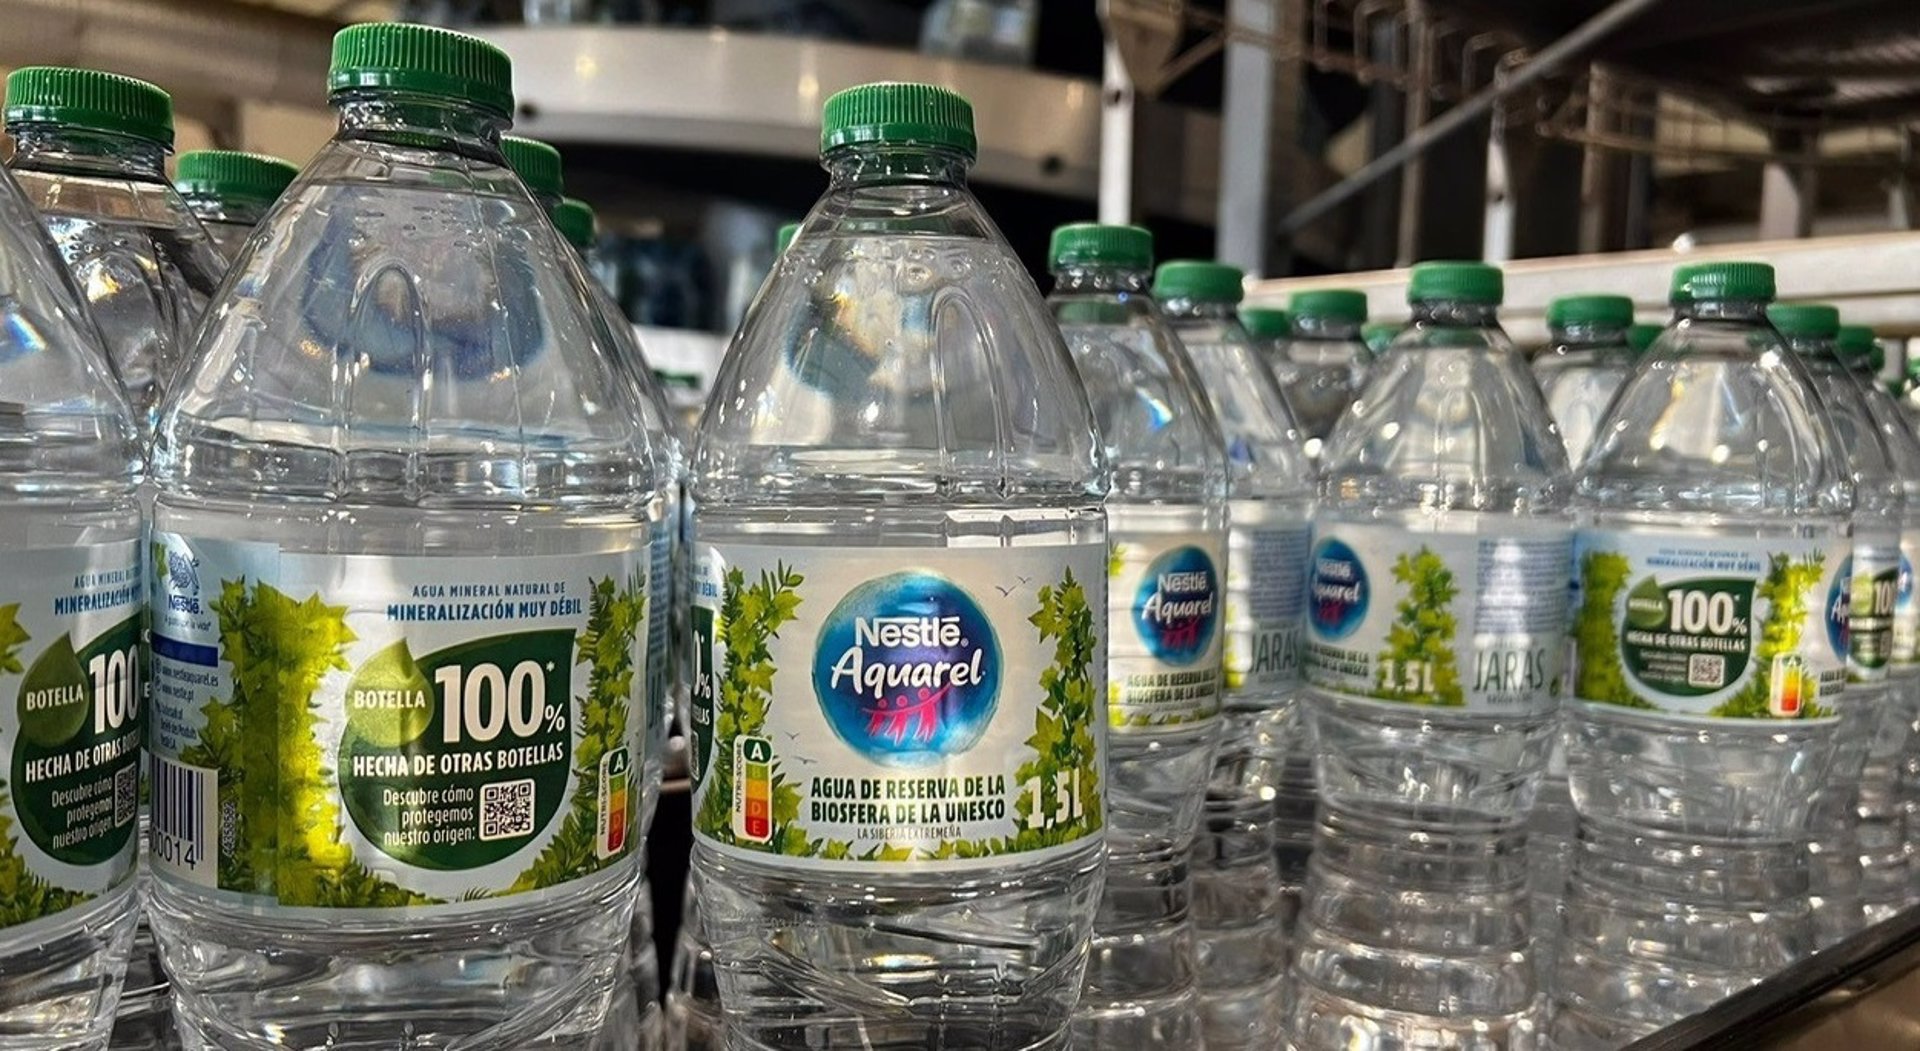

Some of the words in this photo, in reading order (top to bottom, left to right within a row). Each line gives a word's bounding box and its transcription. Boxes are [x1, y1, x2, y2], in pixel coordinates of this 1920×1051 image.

[74, 574, 96, 589] AGUA
[412, 585, 445, 598] AGUA
[449, 584, 501, 597] MINERAL
[504, 582, 551, 596] NATURAL
[553, 581, 566, 594] DE
[1157, 571, 1208, 593] Nestlé
[387, 599, 515, 622] MINERALIZACIÓN
[518, 601, 547, 619] MUY
[550, 597, 582, 616] DÉBIL
[1141, 591, 1213, 624] Aquarel
[855, 616, 962, 649] Nestlé
[1626, 631, 1654, 644] HECHA
[1655, 633, 1667, 646] DE
[1668, 634, 1699, 648] OTRAS
[1700, 637, 1746, 652] BOTELLAS
[831, 648, 985, 698] Aquarel
[1127, 673, 1155, 688] AGUA
[1156, 673, 1169, 687] DE
[1170, 671, 1200, 686] RESERVA
[1381, 659, 1434, 692] 1,5L
[1472, 648, 1545, 692] JARAS
[26, 682, 84, 711] BOTELLA
[353, 689, 426, 710] BOTELLA
[1127, 687, 1172, 704] BIOSFERA
[1173, 687, 1184, 702] DE
[1185, 684, 1194, 699] LA
[25, 753, 72, 783] HECHA
[75, 747, 91, 772] DE
[93, 738, 121, 766] OTRAS
[352, 754, 409, 778] HECHA
[413, 753, 436, 776] DE
[439, 749, 493, 774] OTRAS
[497, 742, 564, 770] BOTELLAS
[613, 752, 625, 773] A
[751, 742, 764, 760] A
[51, 783, 93, 808] Descubre
[382, 787, 440, 807] Descubre
[441, 785, 474, 803] cómo
[811, 776, 855, 800] AGUA
[860, 778, 881, 800] DE
[886, 778, 959, 800] RESERVA
[963, 776, 983, 798] DE
[988, 774, 1005, 796] LA
[1025, 766, 1083, 830] 1,5L
[401, 805, 474, 826] protegemos
[810, 801, 891, 825] BIOSFERA
[896, 804, 916, 825] DE
[921, 803, 941, 825] LA
[945, 799, 1005, 824] UNESCO
[384, 827, 431, 847] nuestro
[432, 824, 476, 846] origen:
[857, 826, 868, 839] LA
[870, 826, 907, 841] SIBERIA
[907, 824, 962, 840] EXTREMEÑA
